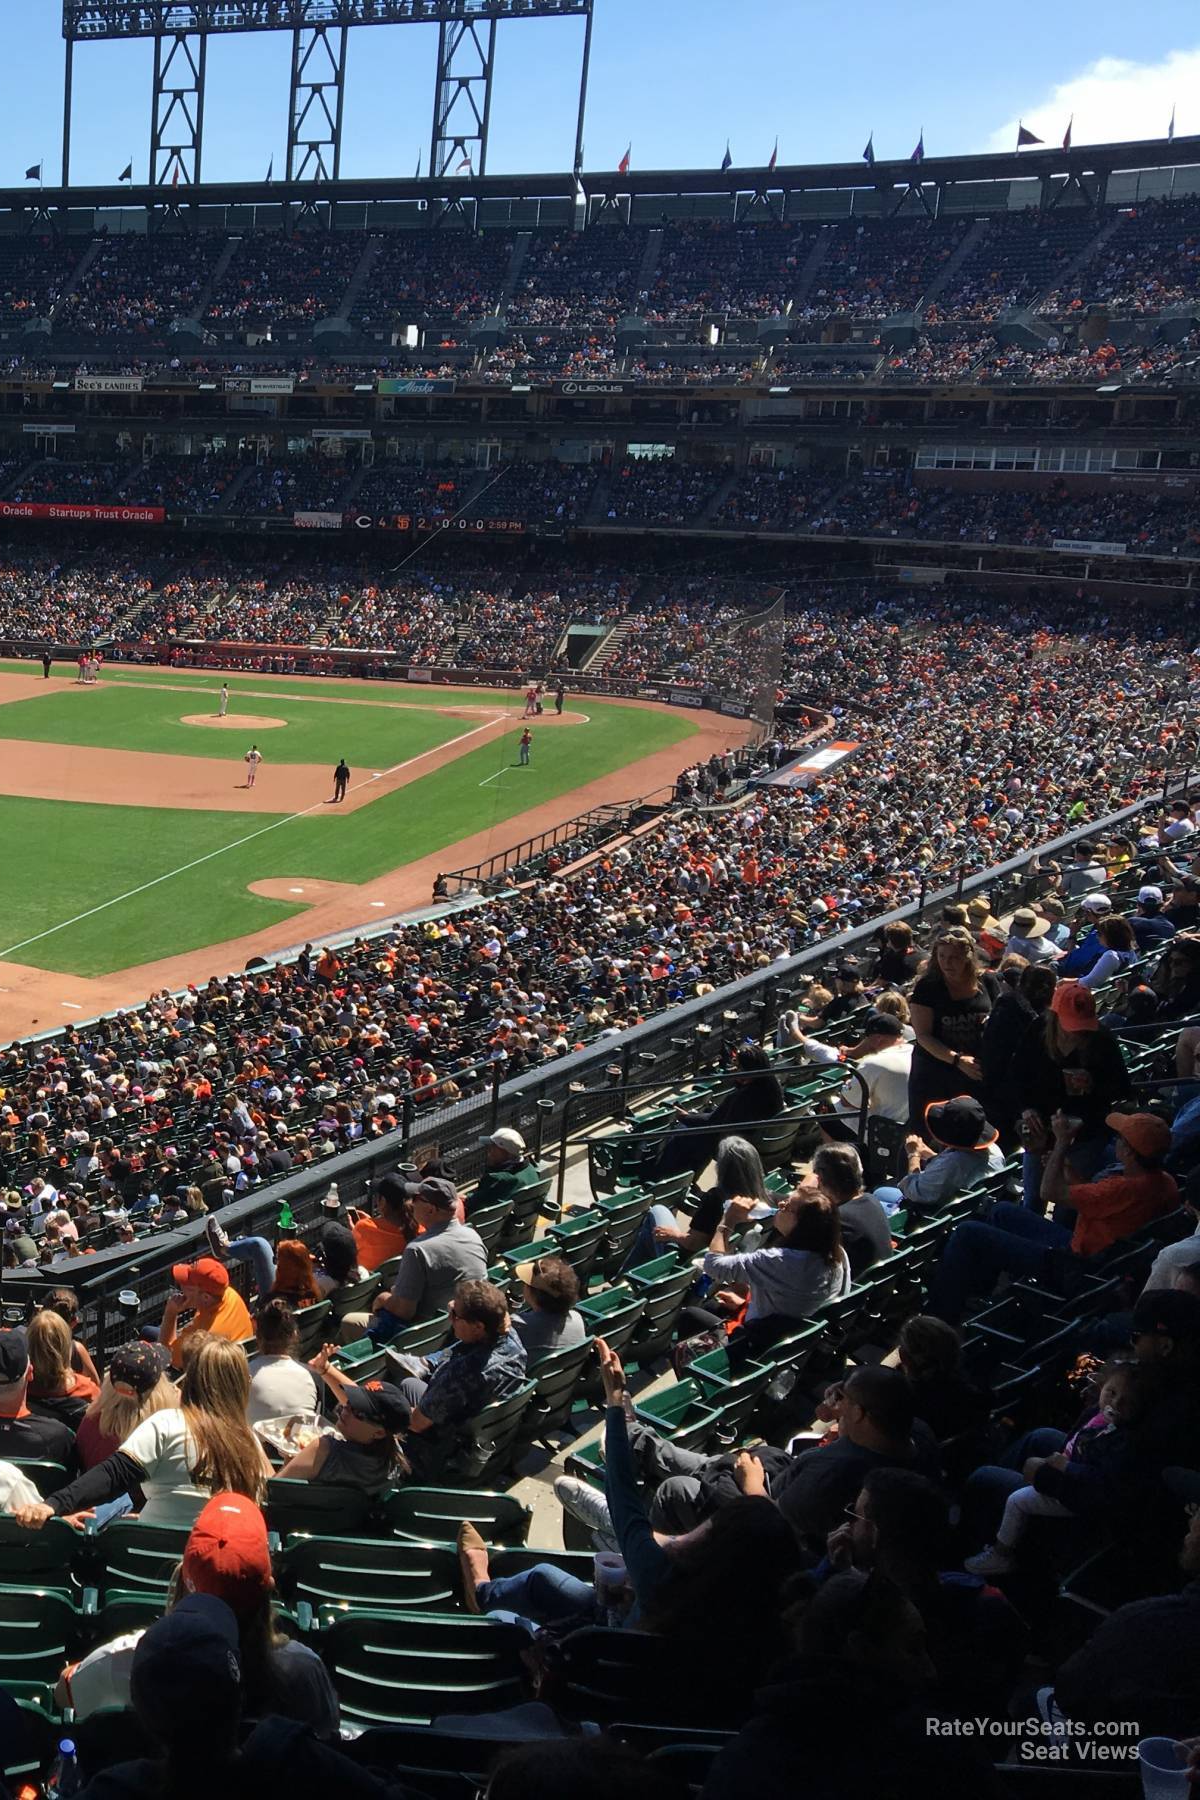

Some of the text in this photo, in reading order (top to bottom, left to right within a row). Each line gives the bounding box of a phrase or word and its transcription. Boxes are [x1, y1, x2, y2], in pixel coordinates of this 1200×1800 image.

[77, 379, 139, 391] See's CANDIES
[399, 380, 434, 393] Alaska
[578, 385, 623, 393] LEXUS
[2, 505, 33, 516] Oracle
[48, 507, 154, 521] Startups Trust Oracle
[417, 518, 426, 529] 2
[509, 521, 522, 529] PM
[670, 693, 703, 706] GEICO
[720, 702, 745, 715] GEICO
